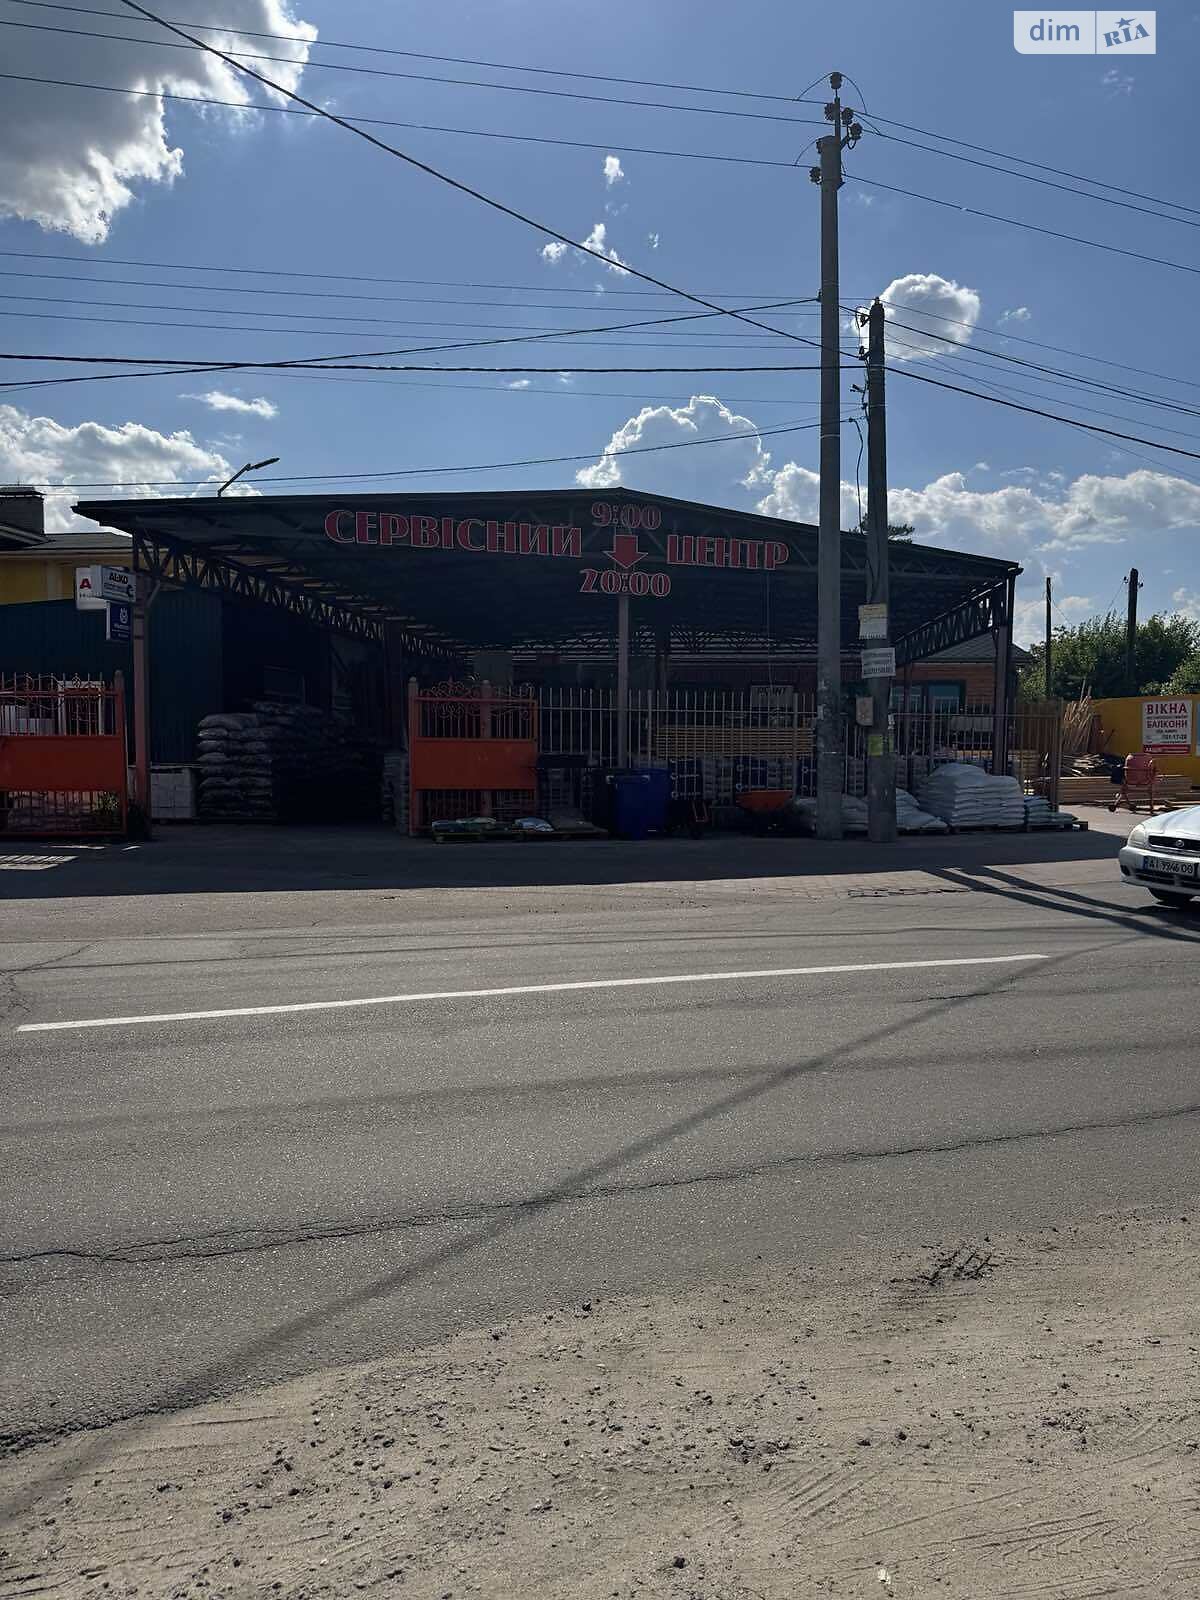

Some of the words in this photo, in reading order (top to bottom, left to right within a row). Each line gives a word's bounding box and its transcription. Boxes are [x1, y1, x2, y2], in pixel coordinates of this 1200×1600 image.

[591, 501, 662, 530] 9:00
[666, 534, 790, 571] ЦЕНТР
[579, 568, 672, 597] 20:00
[1146, 703, 1188, 715] ВІКНА
[1146, 719, 1188, 729] БАЛКОНИ
